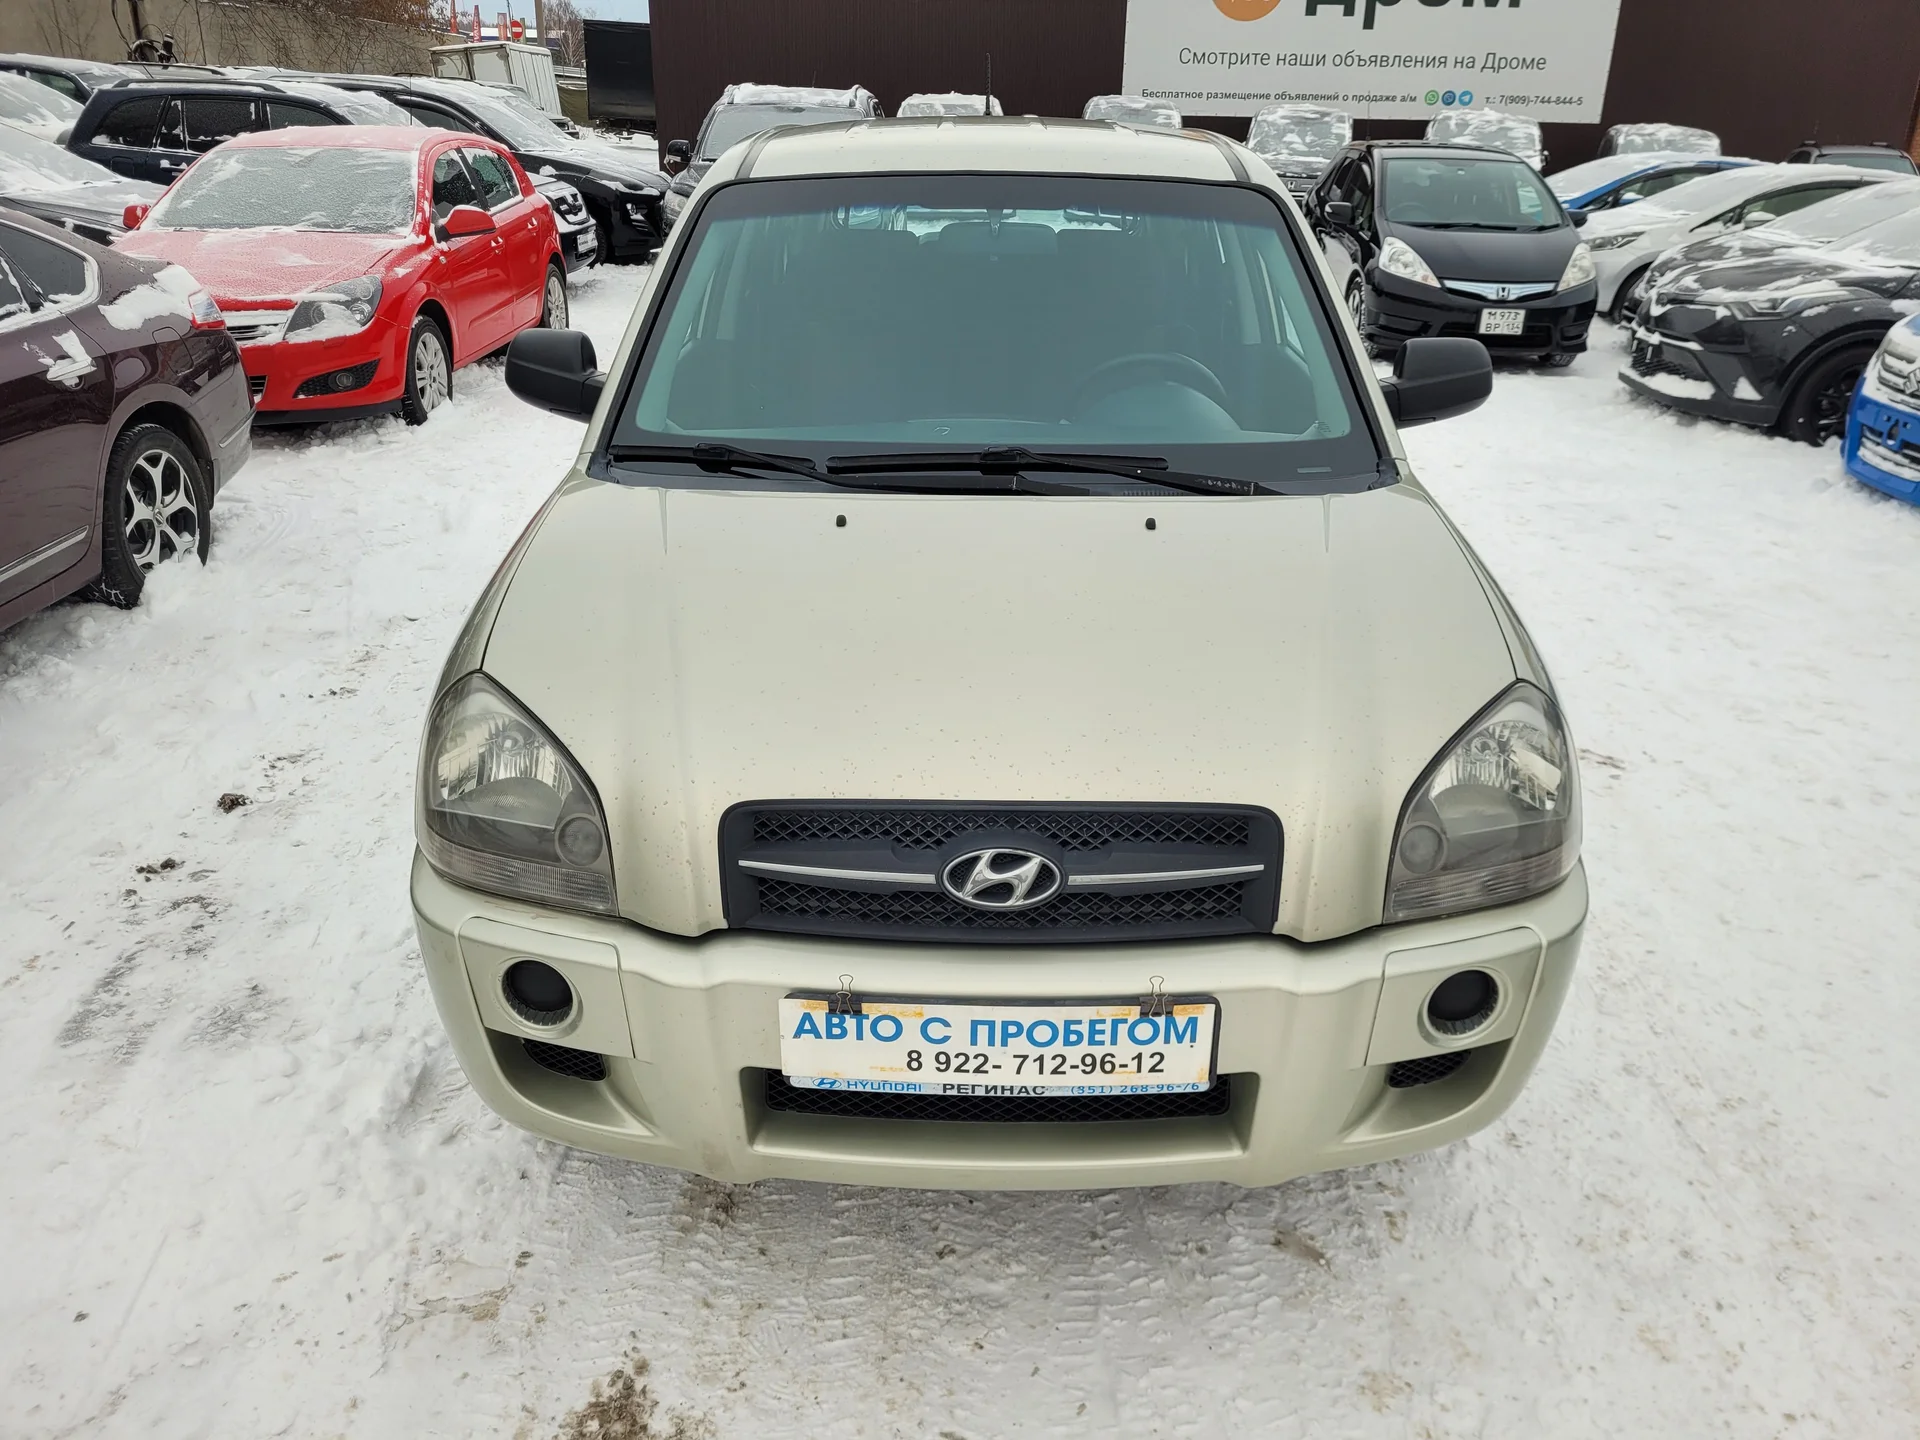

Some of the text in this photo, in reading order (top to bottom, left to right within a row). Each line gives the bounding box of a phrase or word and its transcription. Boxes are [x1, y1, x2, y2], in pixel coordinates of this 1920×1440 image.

[1179, 47, 1547, 73] Смотрите наши объявления на Дроме
[1141, 88, 1204, 99] Бесплатное
[1206, 91, 1271, 101] размещение
[1274, 91, 1340, 101] объявлений
[1351, 93, 1397, 104] продаже
[1400, 93, 1418, 103] а/м
[1499, 94, 1584, 106] 7(909)-744-844-5
[792, 1012, 1199, 1047] АВТО С ПРОБЕГОМ
[906, 1050, 1165, 1075] 8 922- 712-96-12
[847, 1080, 922, 1092] HYUNDAI
[942, 1083, 1046, 1095] РЕГИНАС
